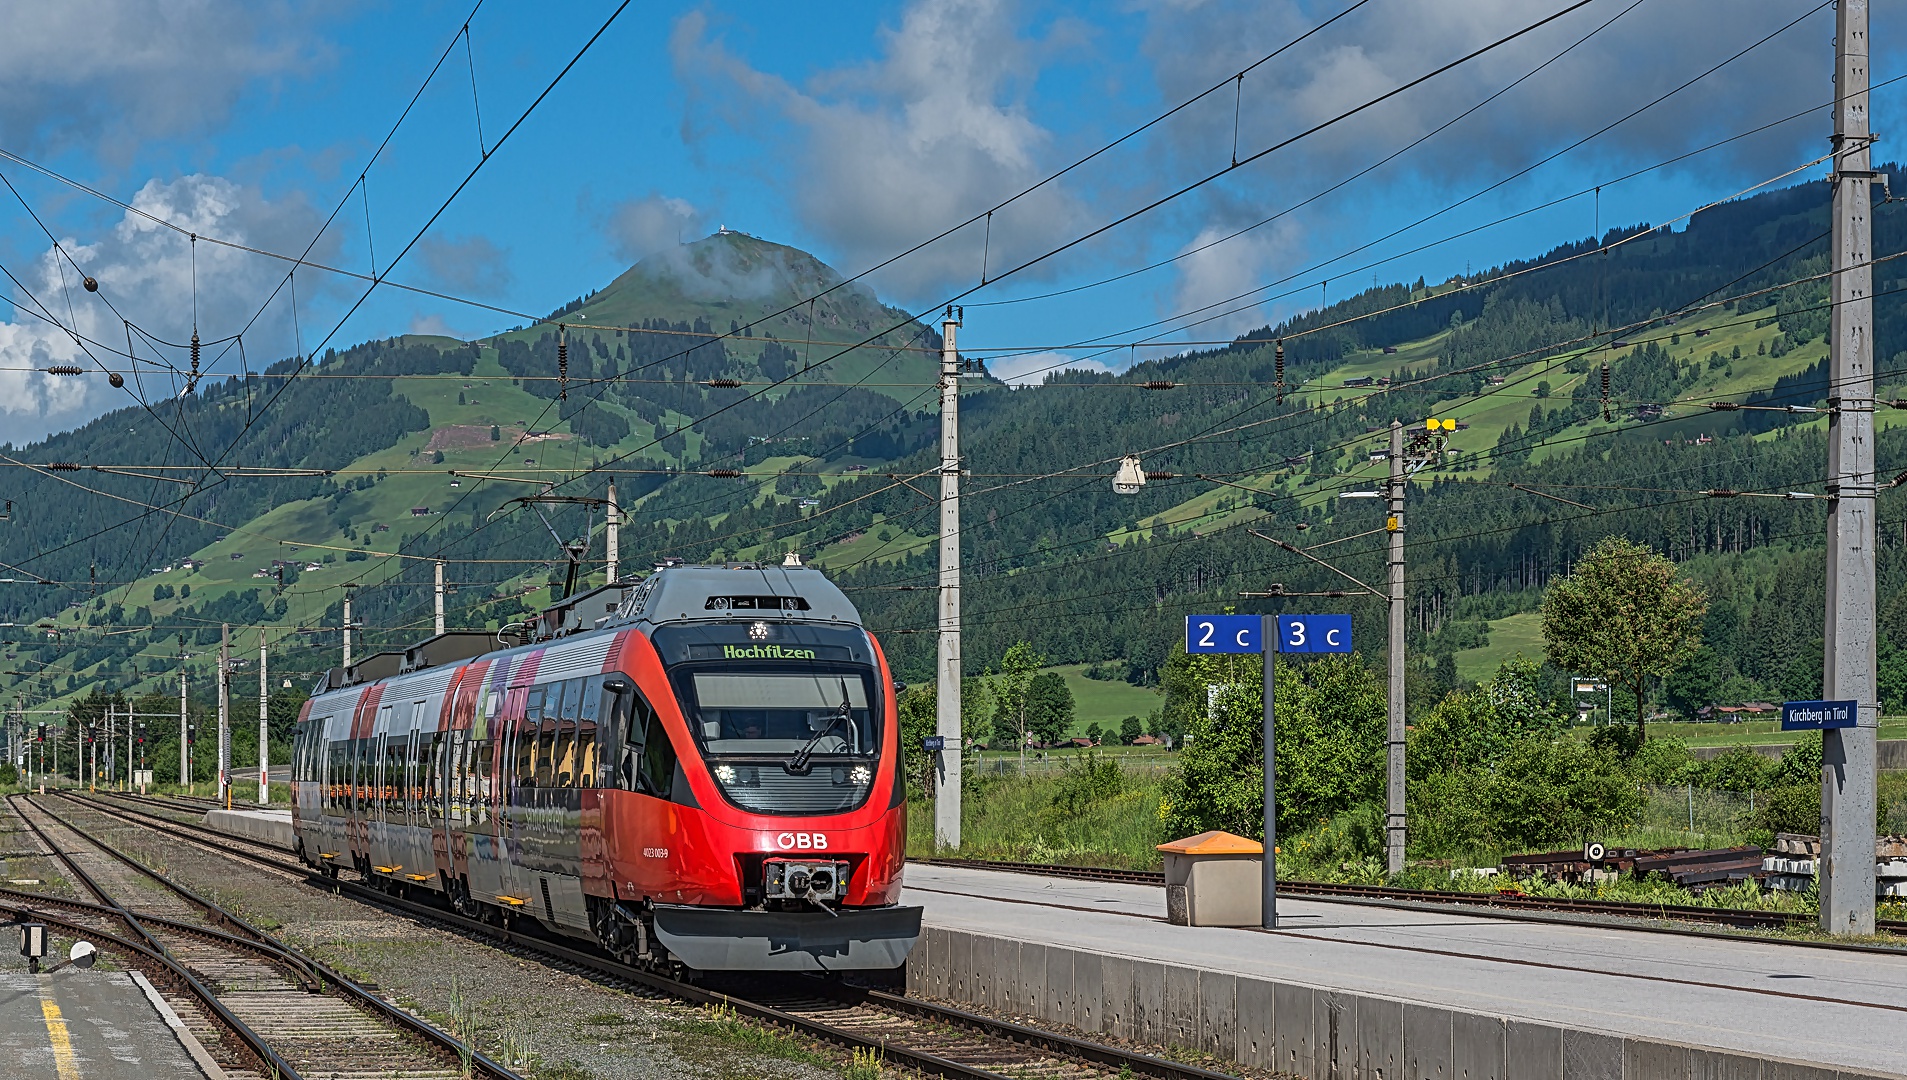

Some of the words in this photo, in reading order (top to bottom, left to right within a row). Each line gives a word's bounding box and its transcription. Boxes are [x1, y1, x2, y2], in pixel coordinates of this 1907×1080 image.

[1198, 621, 1215, 647] 2
[1289, 621, 1305, 646] 3
[723, 645, 815, 659] Hochfilzen
[1789, 707, 1823, 724] Kirchberg
[1824, 707, 1831, 721] in
[1832, 705, 1848, 720] Tirol
[777, 832, 828, 850] ÖBB
[643, 847, 654, 858] 4023
